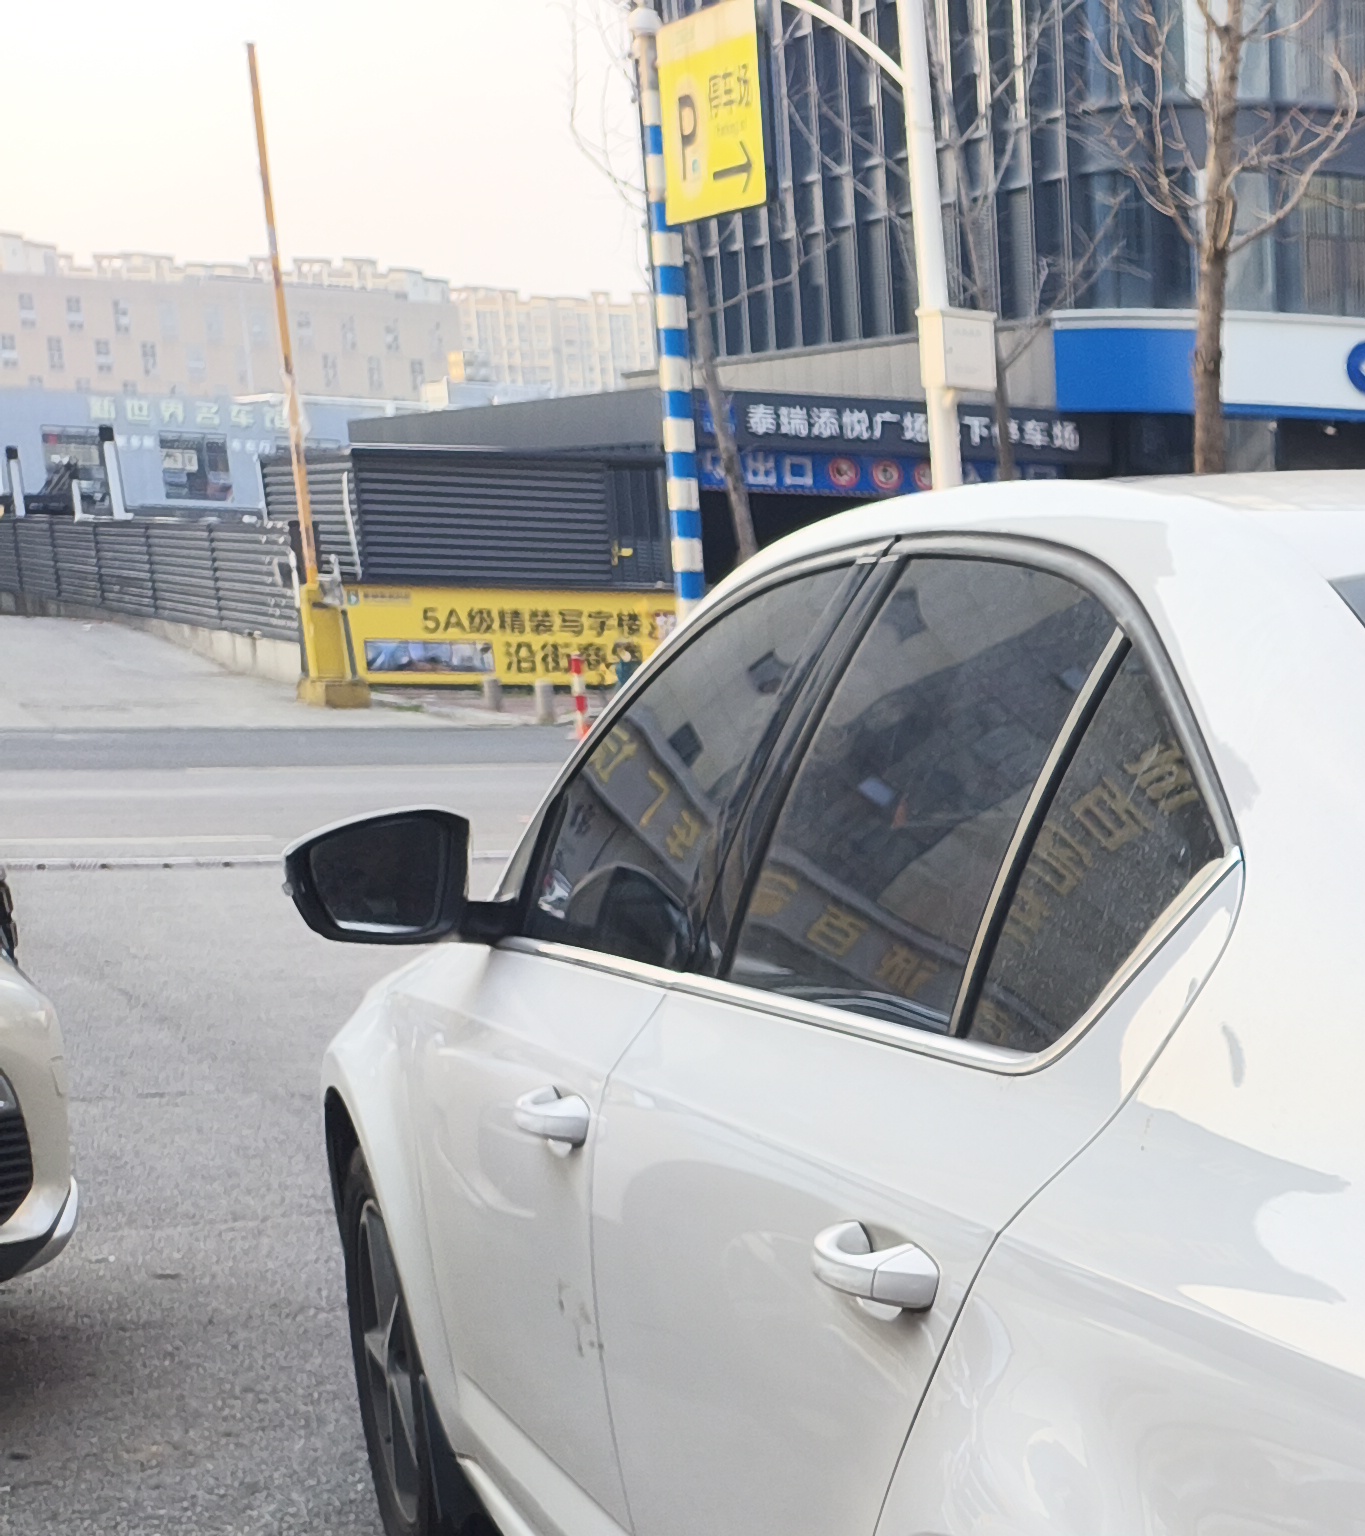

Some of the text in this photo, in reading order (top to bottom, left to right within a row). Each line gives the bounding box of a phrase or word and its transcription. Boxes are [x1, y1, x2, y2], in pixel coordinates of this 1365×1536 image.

[708, 63, 752, 121] 停车场
[677, 94, 698, 181] P
[746, 403, 1080, 451] 泰瑞添悦广场下停车场
